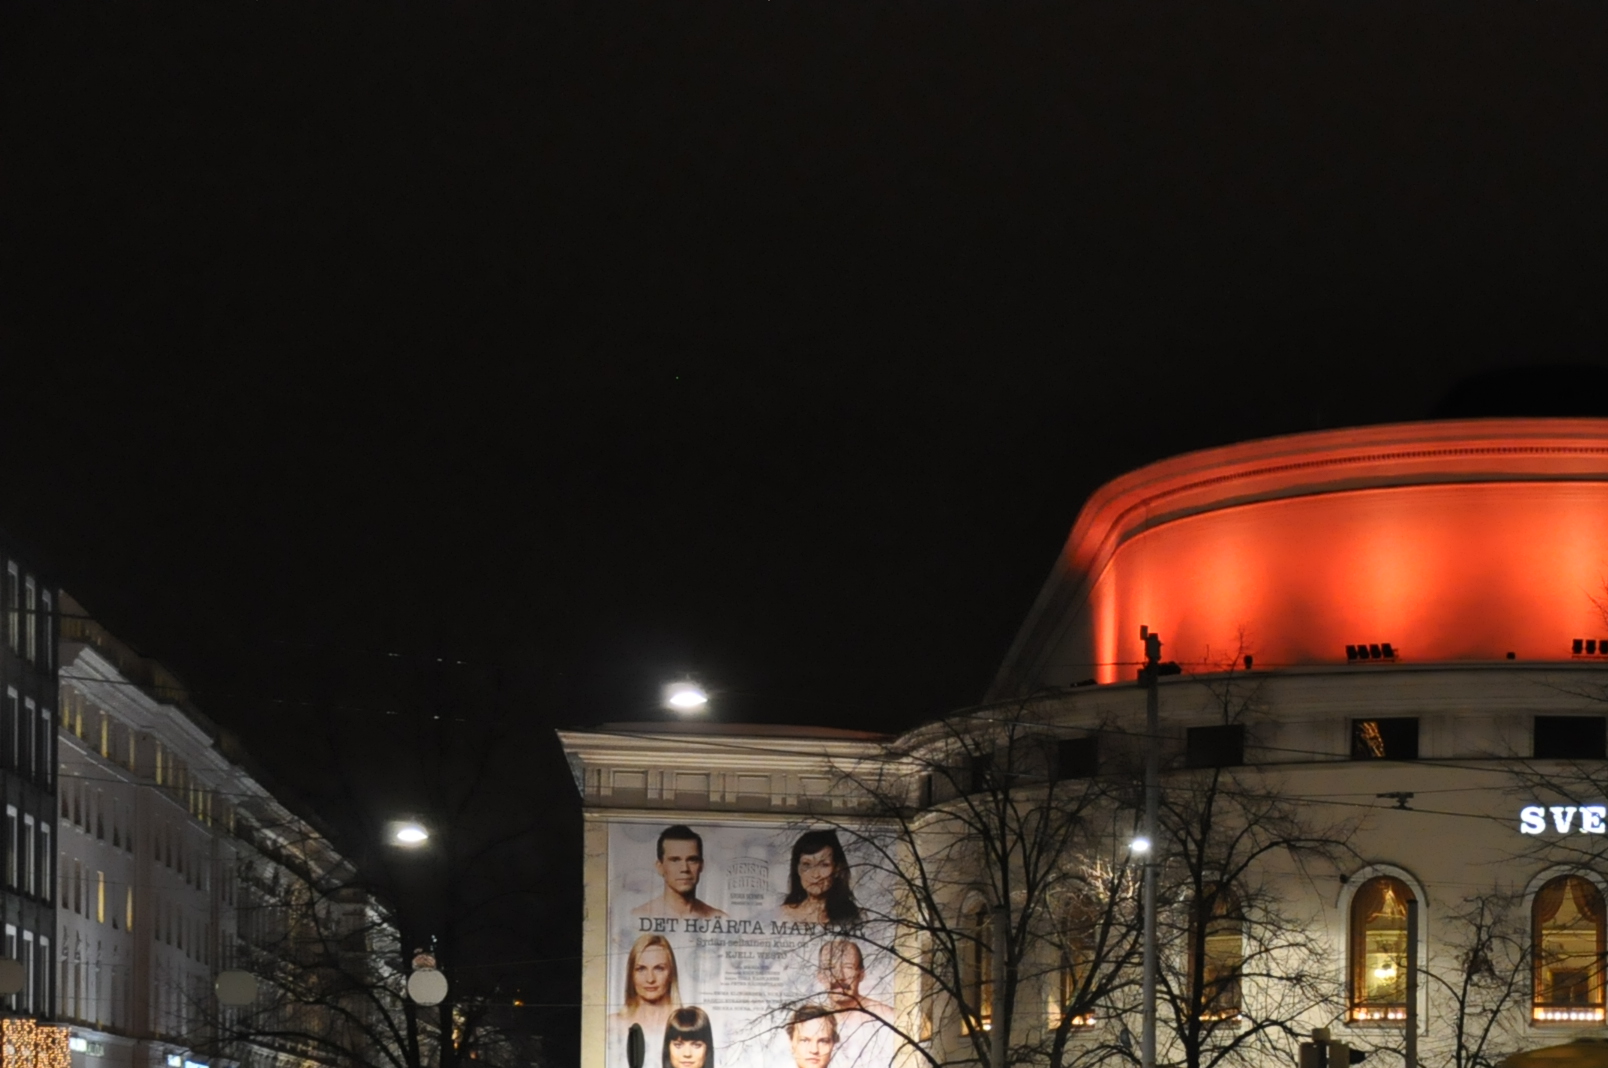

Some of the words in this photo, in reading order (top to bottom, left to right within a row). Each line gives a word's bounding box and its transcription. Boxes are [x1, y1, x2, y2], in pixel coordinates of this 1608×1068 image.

[638, 917, 679, 932] DET
[683, 916, 765, 934] HJÄRTA
[769, 920, 818, 936] MAN
[725, 951, 755, 959] KJELL
